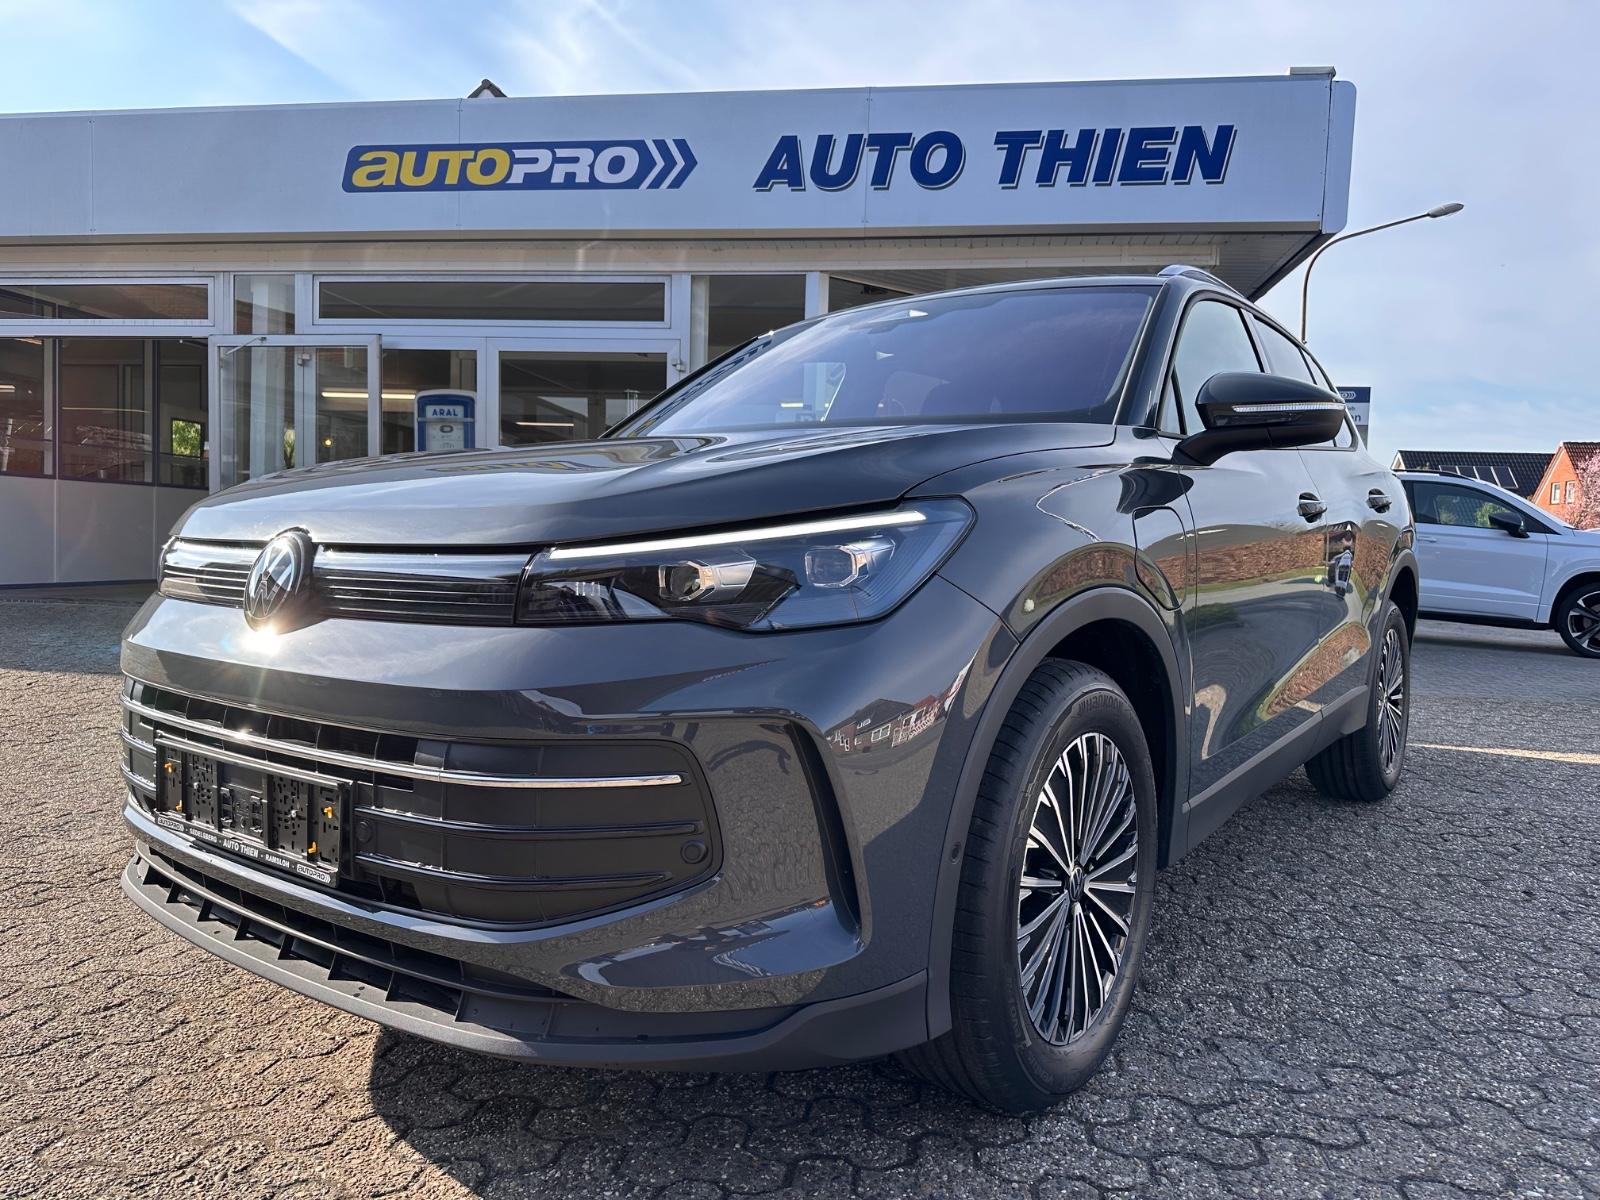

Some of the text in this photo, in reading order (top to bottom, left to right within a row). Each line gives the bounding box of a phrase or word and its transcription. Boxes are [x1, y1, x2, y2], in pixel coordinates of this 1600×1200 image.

[752, 124, 1237, 192] AUTO THIEN
[432, 408, 458, 417] ARAL
[222, 838, 240, 851] AUTO
[240, 844, 259, 859] THIEN
